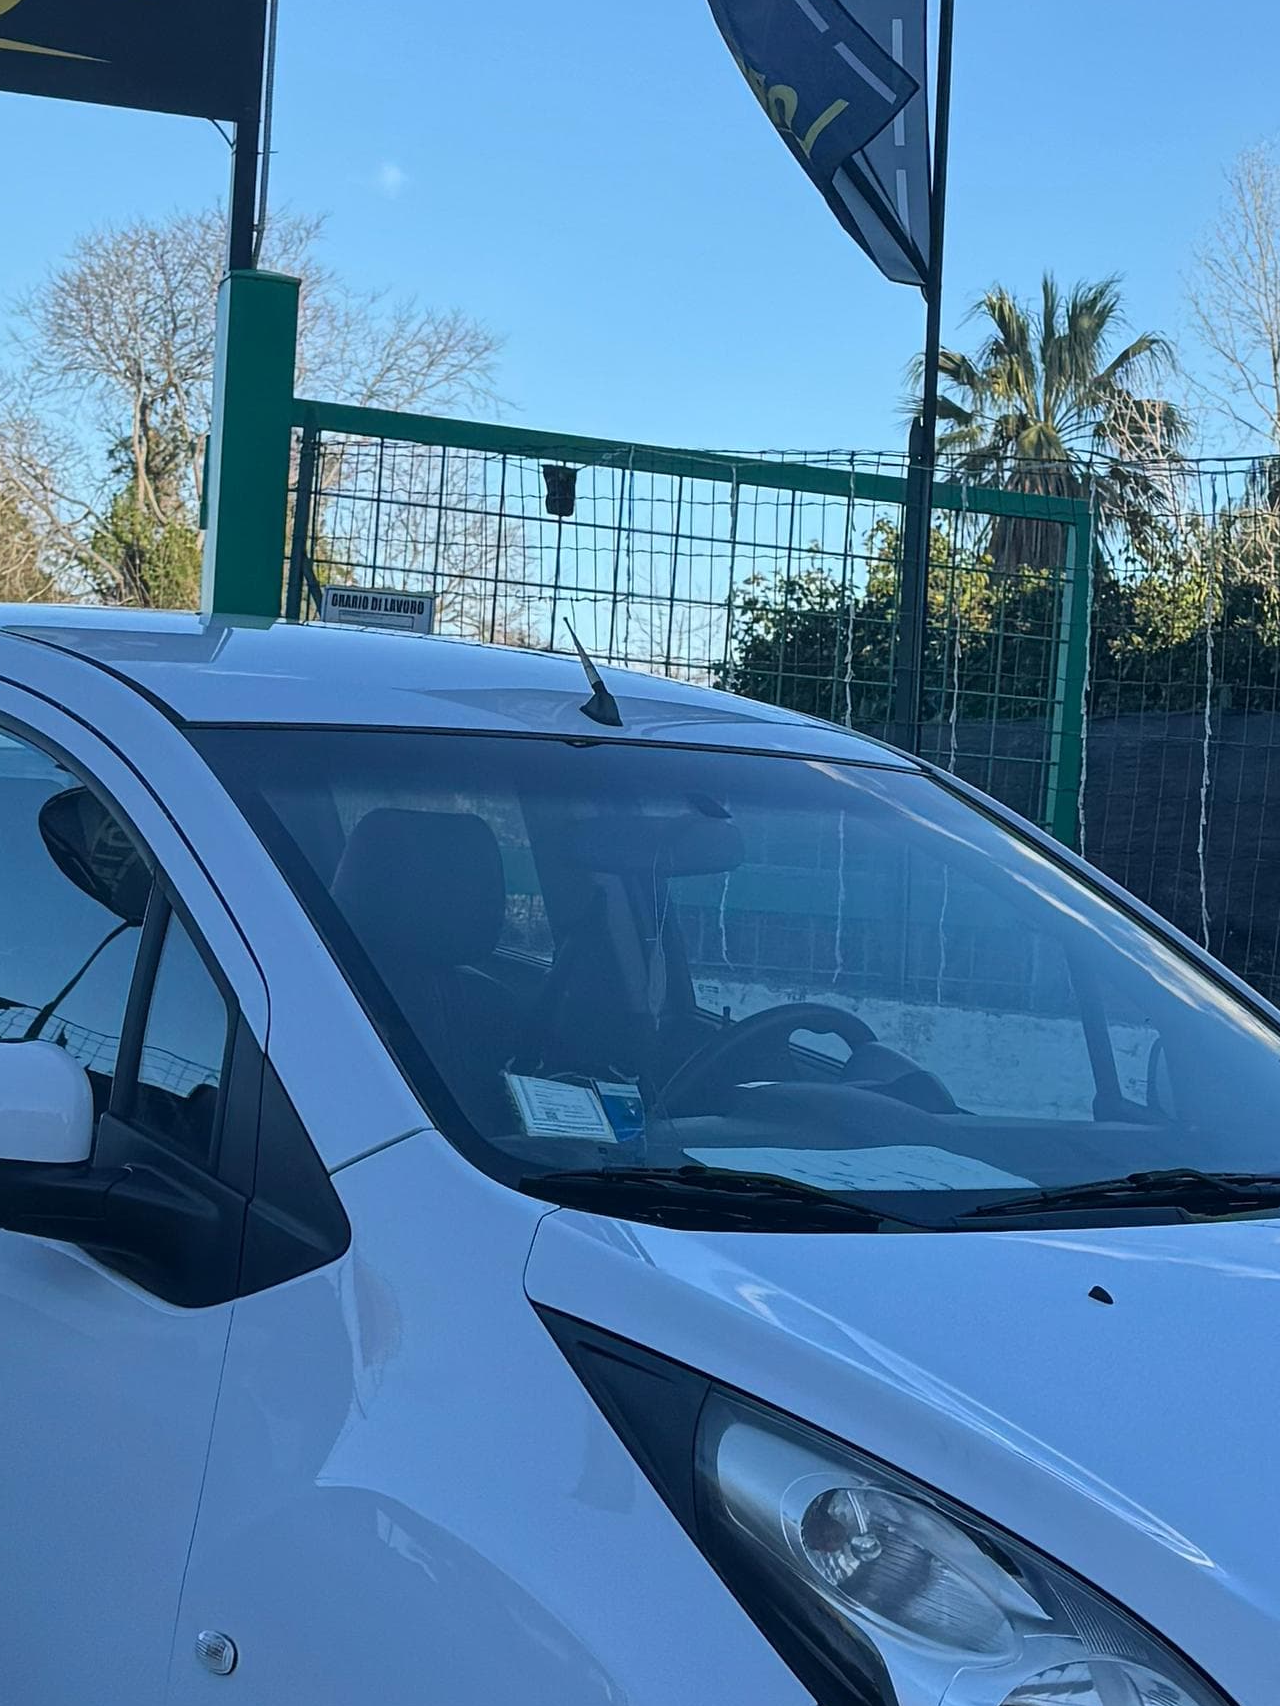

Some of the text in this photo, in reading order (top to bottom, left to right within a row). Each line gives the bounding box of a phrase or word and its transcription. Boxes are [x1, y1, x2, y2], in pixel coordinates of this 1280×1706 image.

[331, 593, 425, 615] ORARIO DI LAVORO
